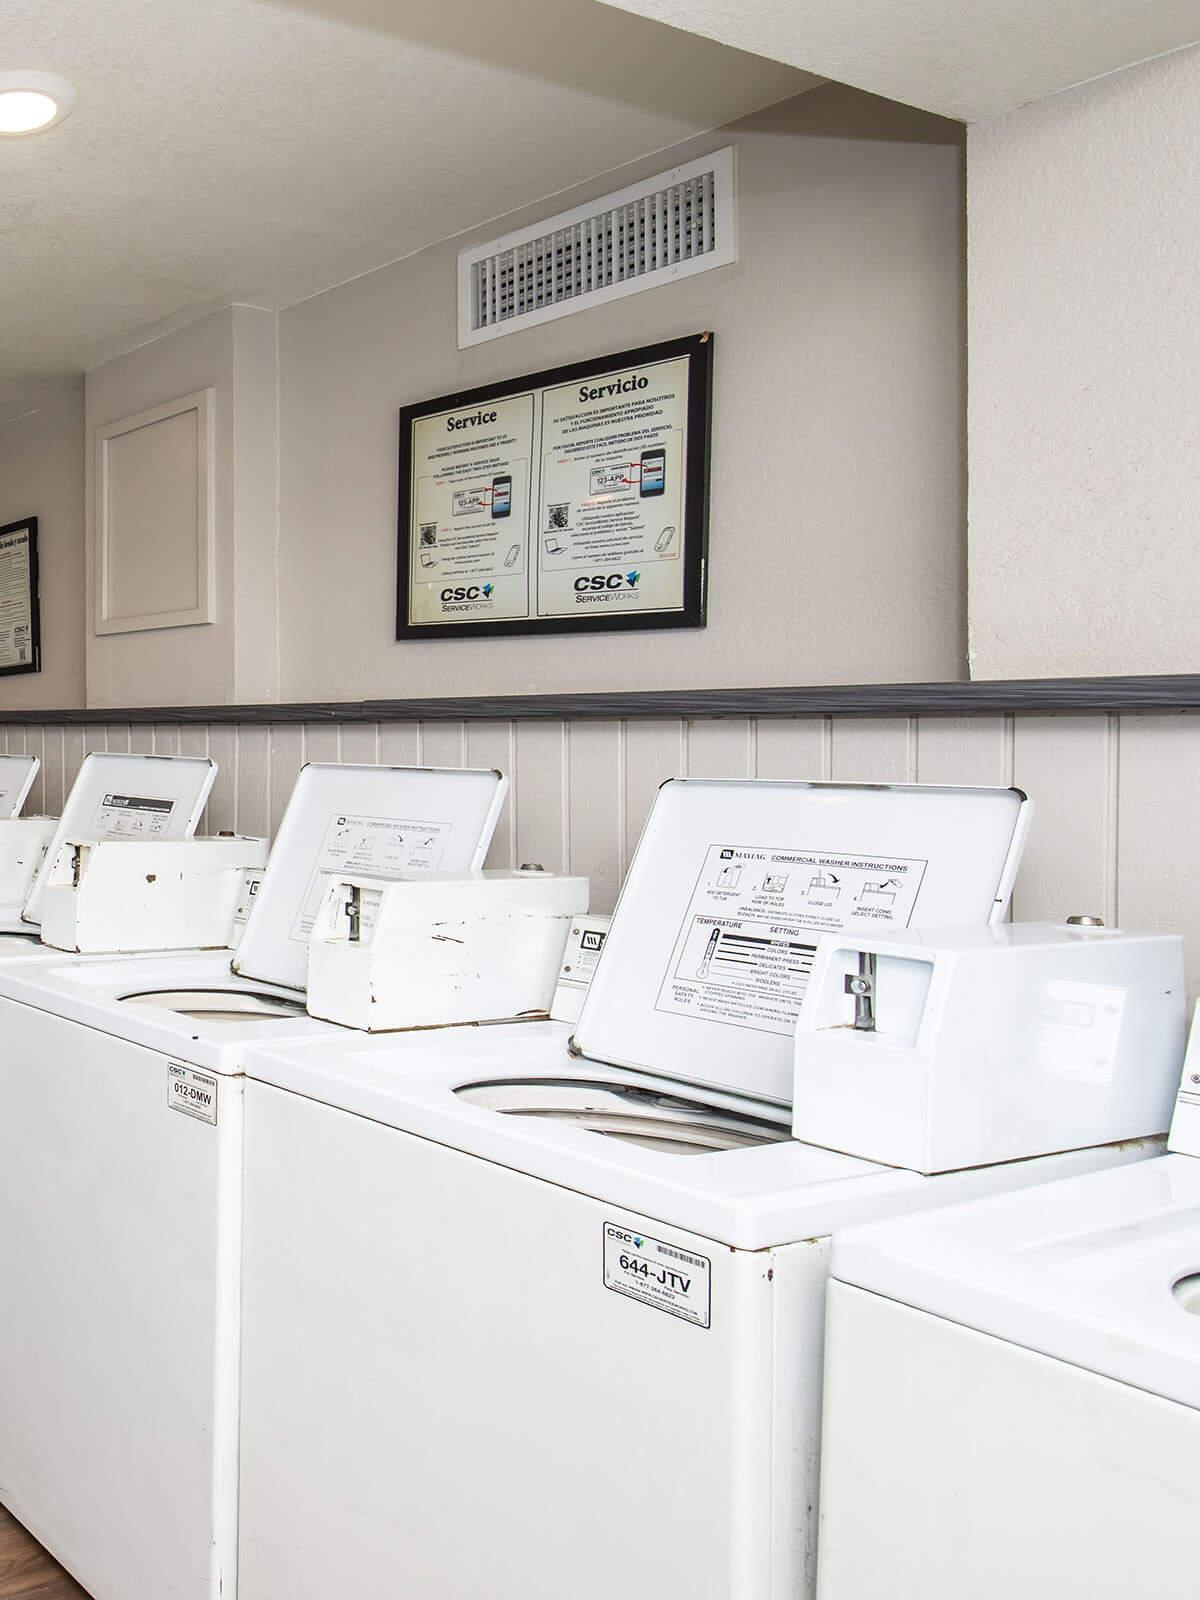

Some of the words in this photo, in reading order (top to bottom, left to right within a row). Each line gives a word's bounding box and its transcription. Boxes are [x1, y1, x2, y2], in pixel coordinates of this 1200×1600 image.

[579, 375, 649, 403] Servicio
[447, 411, 497, 432] Service
[597, 474, 624, 484] 123-APP
[574, 574, 623, 591] CSC
[440, 586, 480, 602] CSC
[771, 855, 816, 863] COMMERCIAL
[819, 857, 850, 866] WASHER
[851, 861, 908, 871] INSTRUCTIONS
[696, 918, 742, 929] TEMPERATURE
[770, 927, 800, 937] SETTING
[751, 954, 783, 962] PERMANENT
[784, 957, 800, 965] PRESS
[759, 962, 786, 971] DELICATES
[750, 969, 768, 977] BRIGHT
[769, 972, 791, 980] COLORS
[672, 985, 699, 994] PERSONAL
[169, 1066, 182, 1075] CSC
[174, 1082, 212, 1105] 012-DMW
[607, 1228, 632, 1243] CSC
[619, 1254, 691, 1293] 644-JTV
